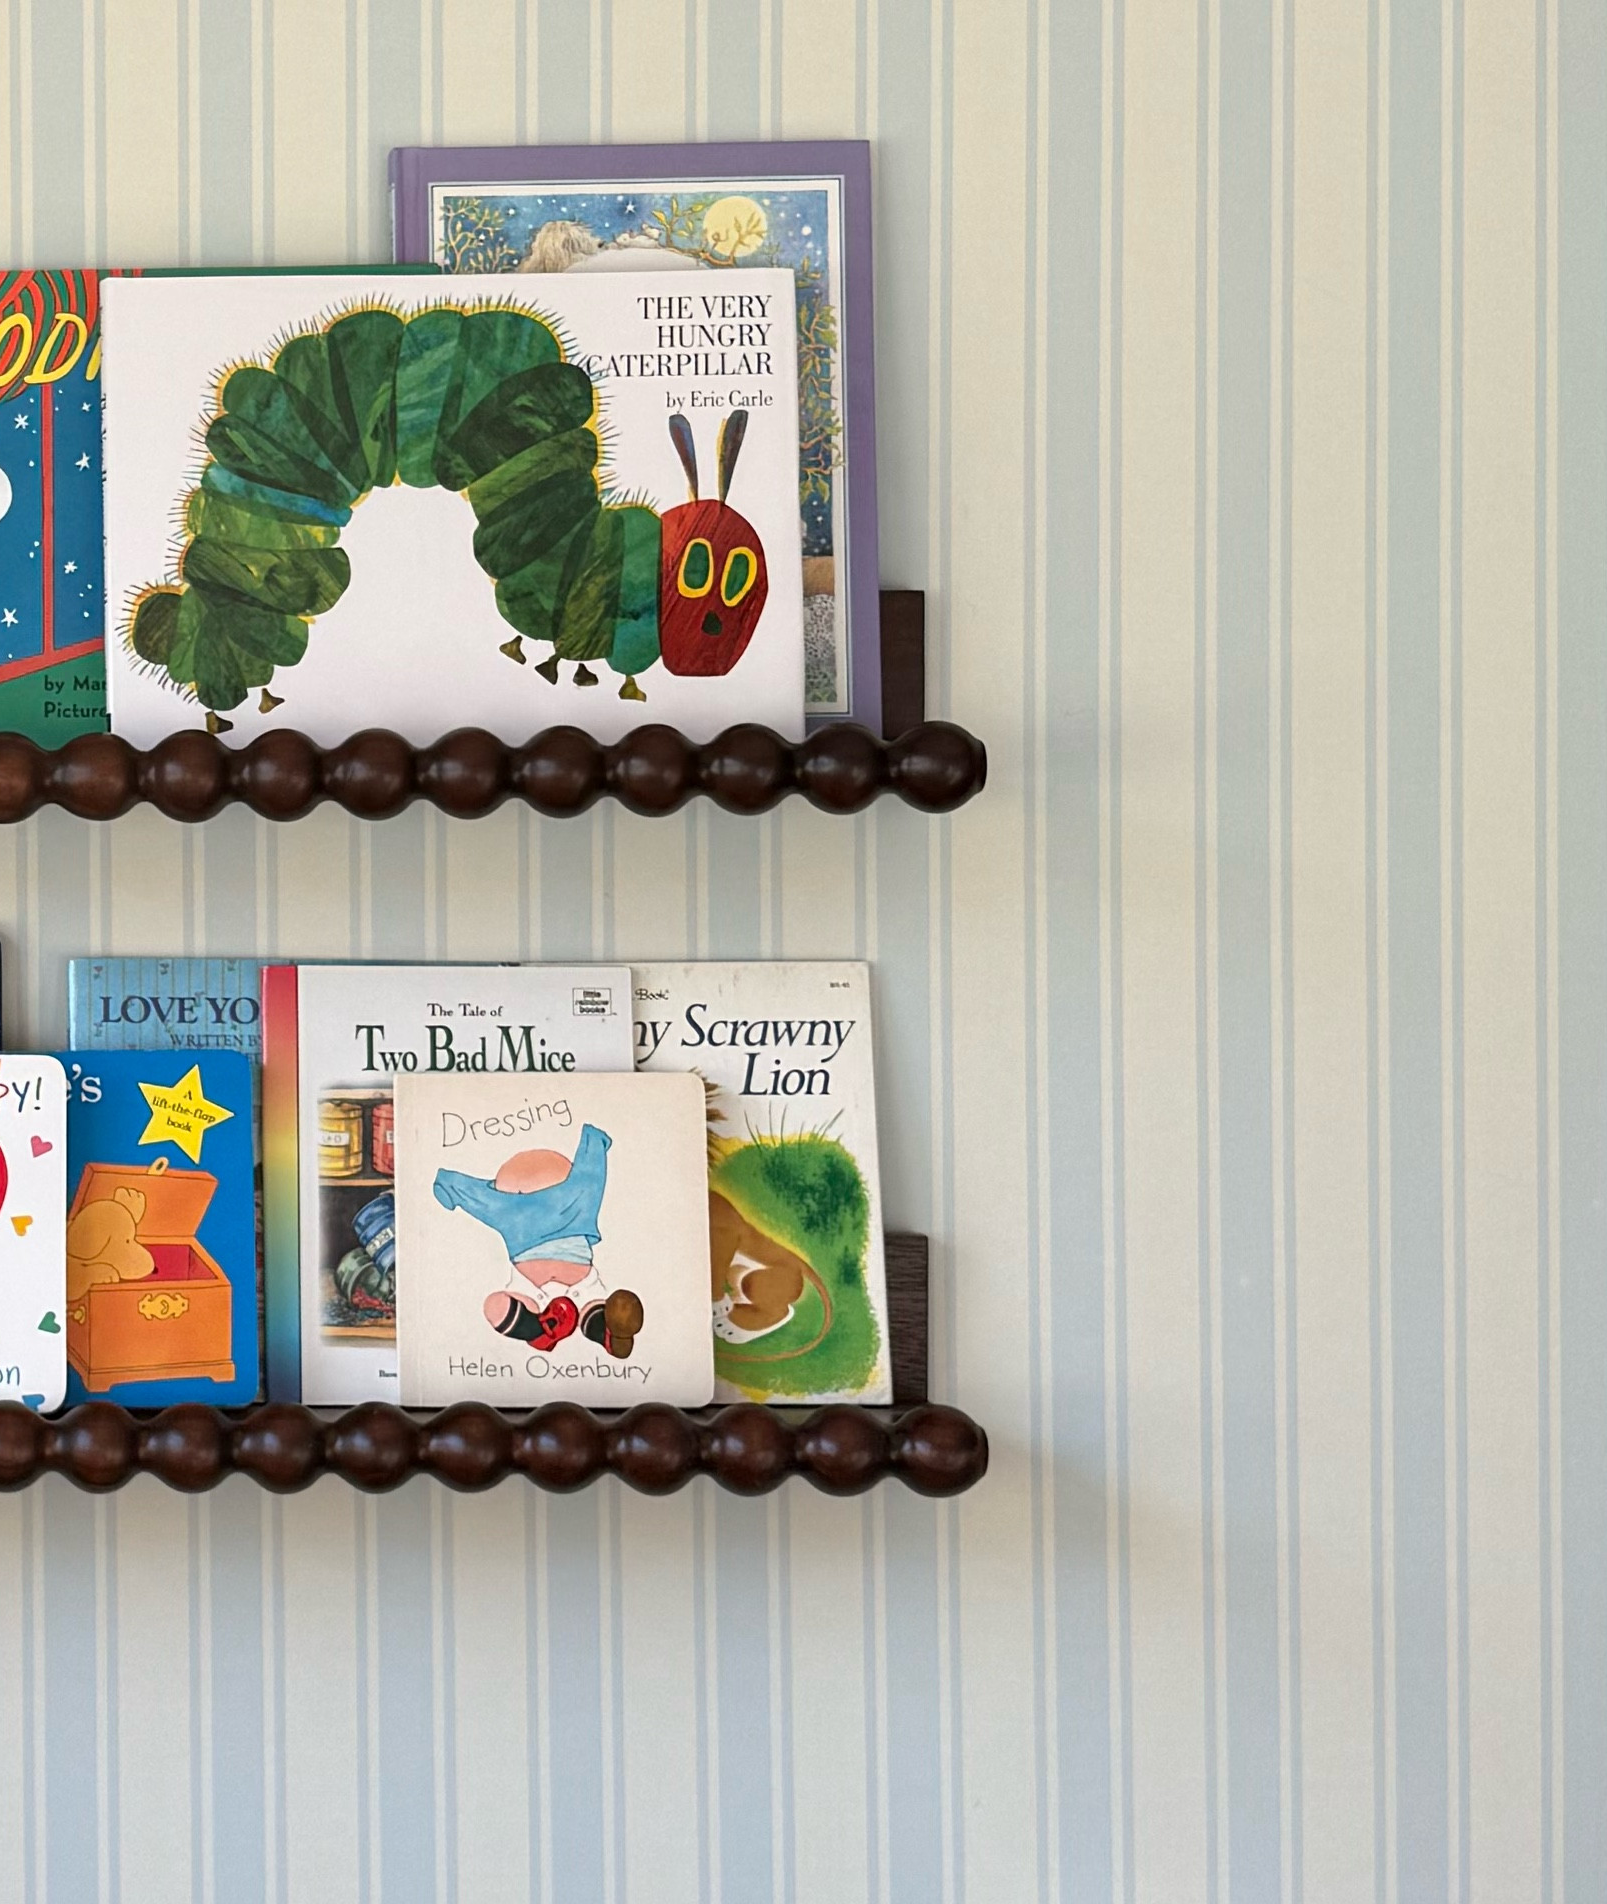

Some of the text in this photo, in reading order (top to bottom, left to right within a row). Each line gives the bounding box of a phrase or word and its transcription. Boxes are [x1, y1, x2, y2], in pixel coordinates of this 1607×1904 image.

[637, 294, 773, 320] THE VERY
[657, 323, 773, 348] HUNGRY
[586, 351, 774, 378] CATERPILLAR
[666, 389, 774, 414] by Eric Carle
[44, 674, 65, 695] by
[99, 996, 198, 1024] LOVE
[427, 1002, 504, 1017] The Tale of
[169, 1034, 243, 1048] WRITTEN
[681, 1003, 856, 1063] Scrawny
[355, 1025, 576, 1072] Two Bad Mice
[739, 1052, 831, 1096] Lion
[183, 1090, 193, 1101] A
[152, 1095, 216, 1124] lift-the-flap
[442, 1098, 572, 1147] Dressing
[166, 1116, 192, 1133] book
[449, 1355, 652, 1383] Helen Oxenbury
